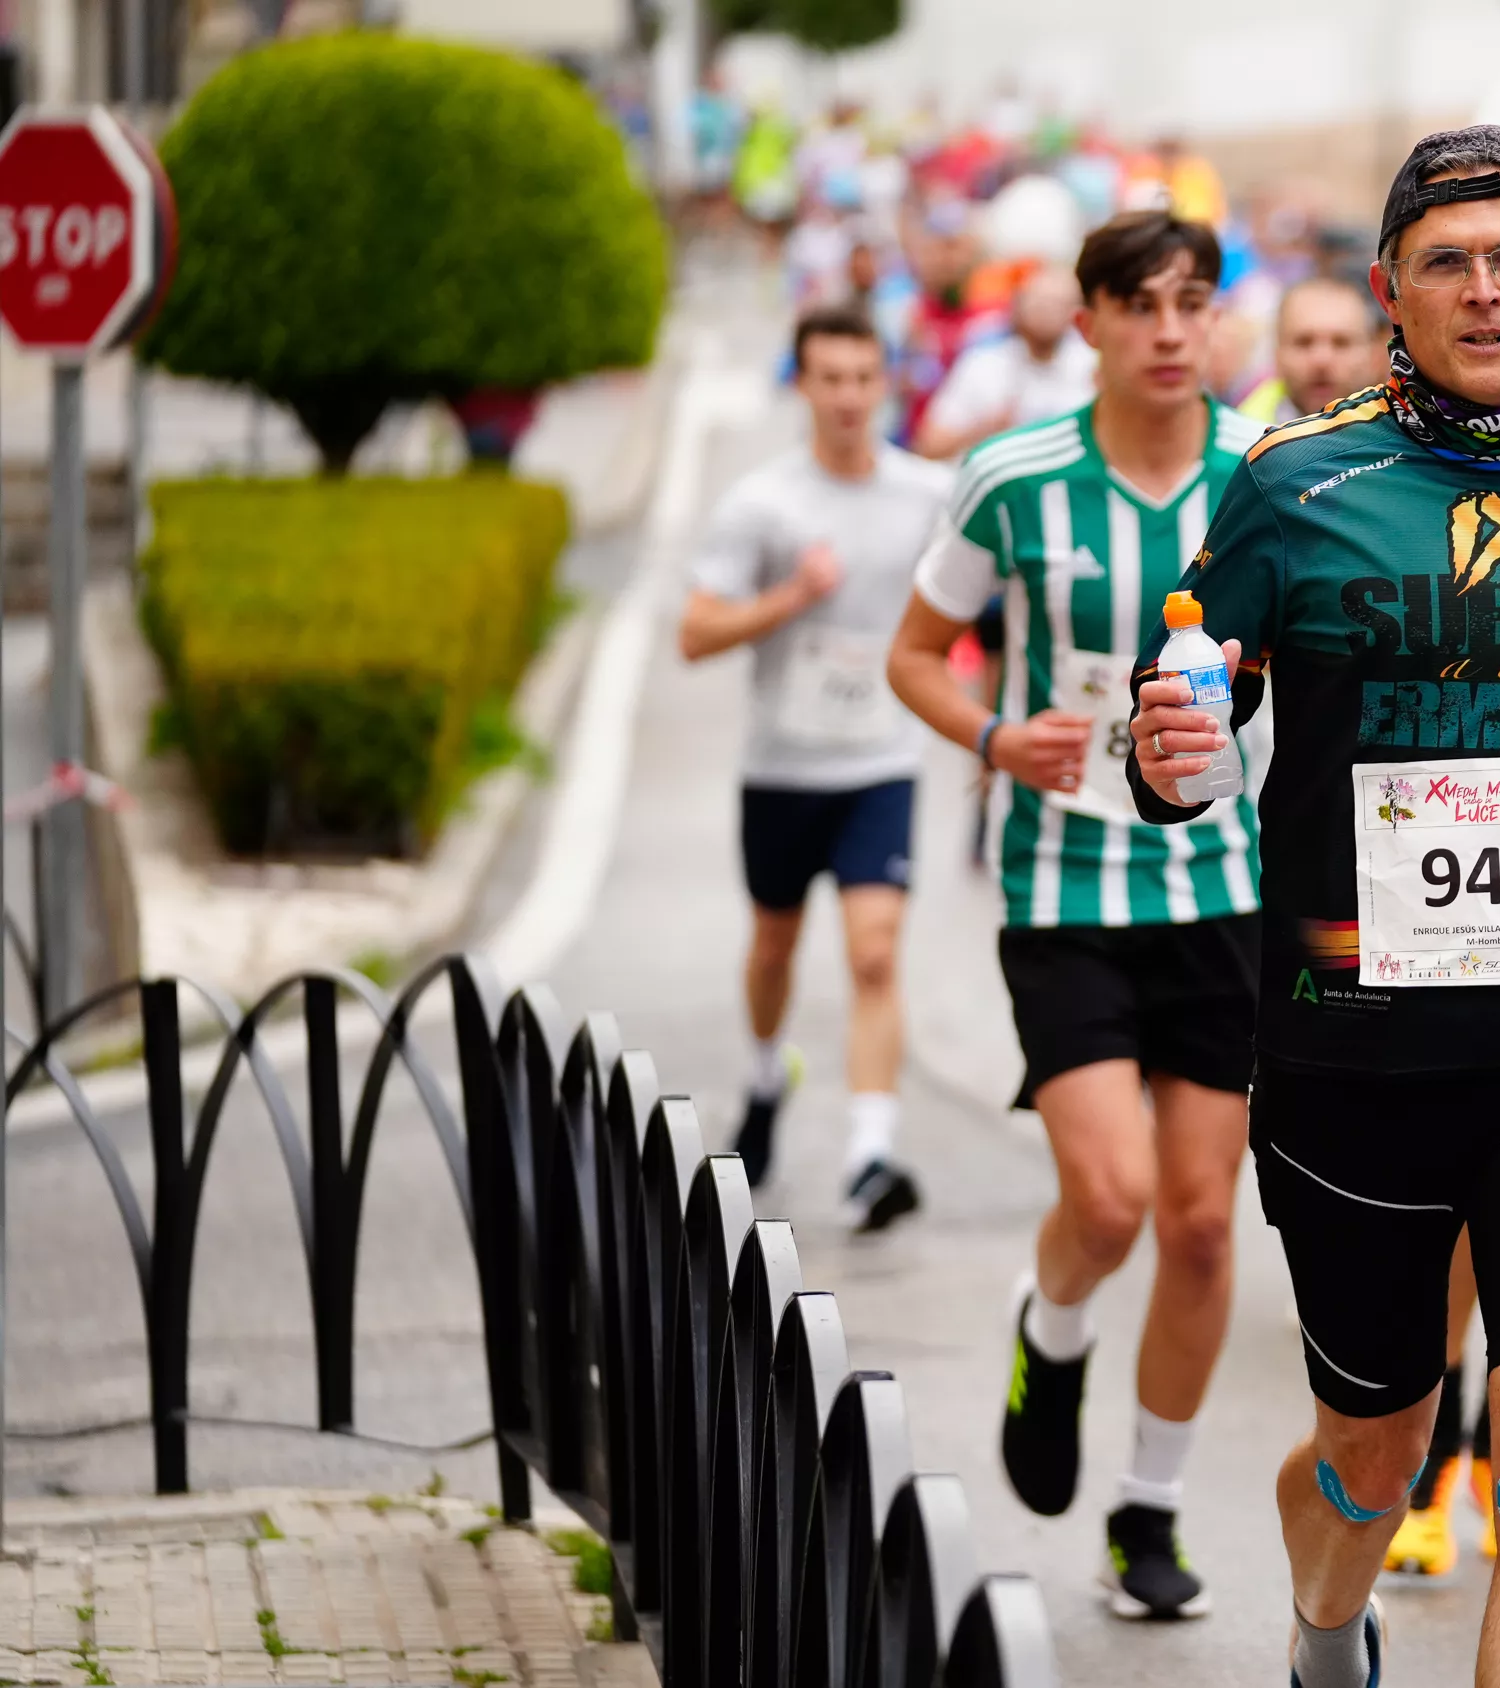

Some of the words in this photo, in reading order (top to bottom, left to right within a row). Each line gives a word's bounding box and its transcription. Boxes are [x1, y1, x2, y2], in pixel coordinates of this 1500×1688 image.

[1298, 452, 1405, 505] FIREHAWK
[1440, 656, 1483, 680] a
[1412, 927, 1450, 936] ENRIQUE
[1451, 924, 1477, 934] JESÚS
[1323, 988, 1343, 998] Junta
[1344, 991, 1353, 999] de
